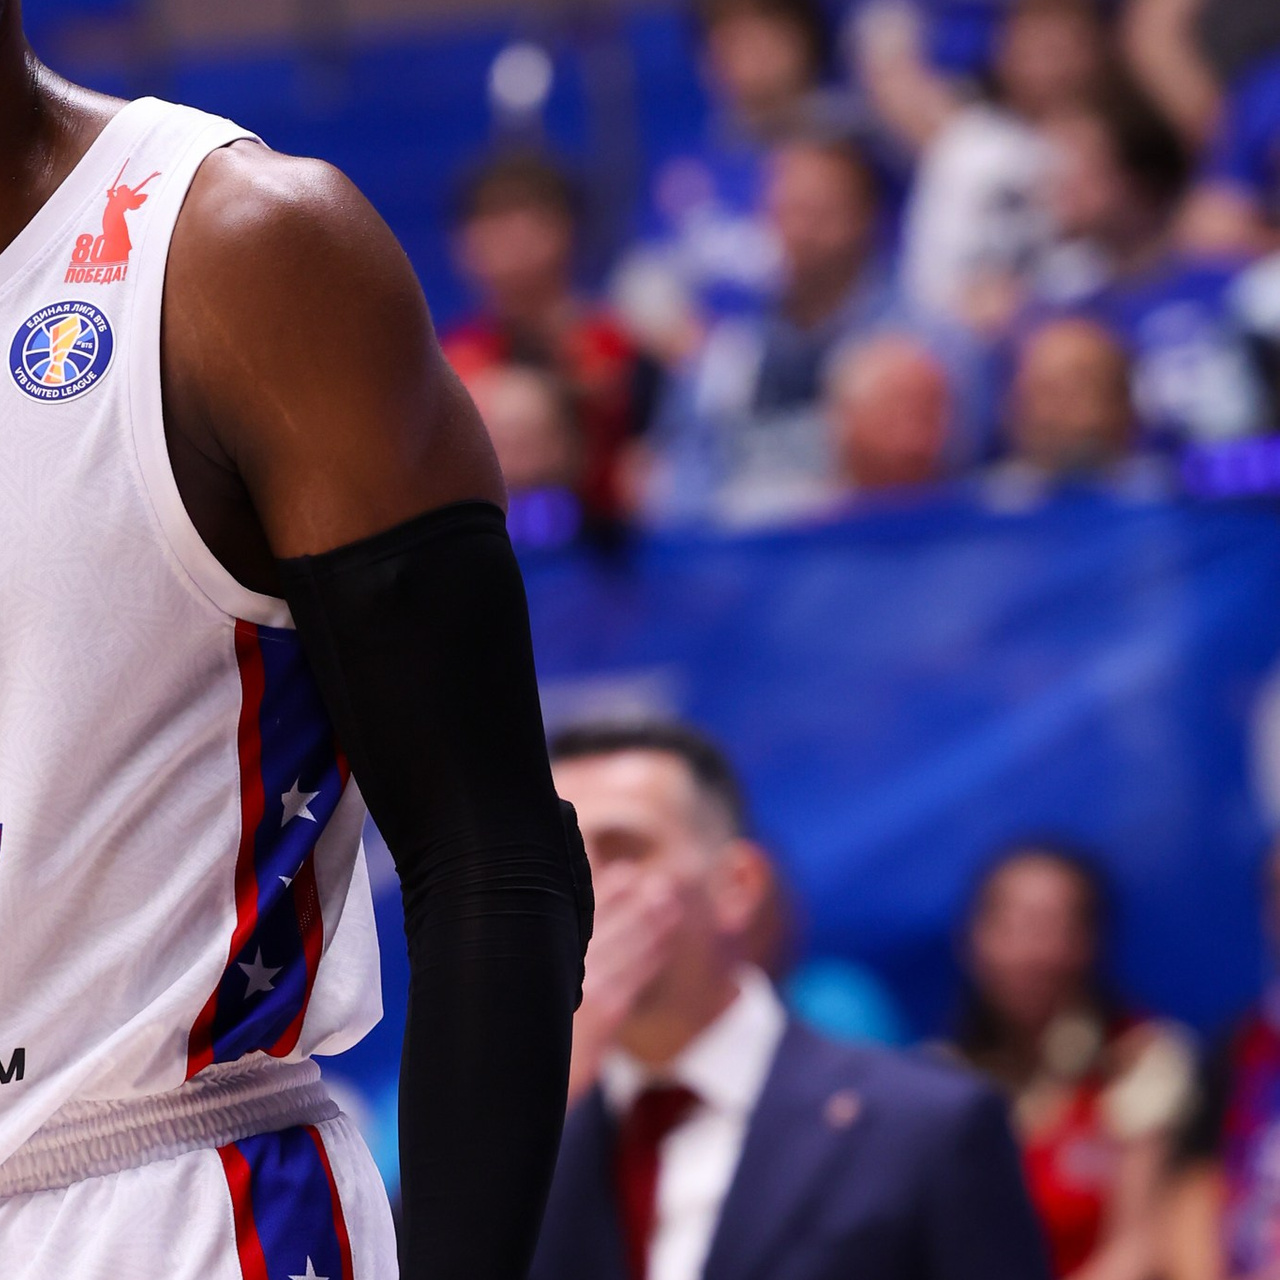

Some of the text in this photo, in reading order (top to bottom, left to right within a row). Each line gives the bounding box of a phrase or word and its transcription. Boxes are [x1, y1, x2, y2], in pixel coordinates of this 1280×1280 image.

[72, 234, 111, 262] 80
[64, 266, 128, 284] ПОБЕДА!
[26, 304, 107, 332] ЕДИНАЯ ЛИГА ВТБ
[15, 367, 97, 398] VTB UNITED LEAGUE
